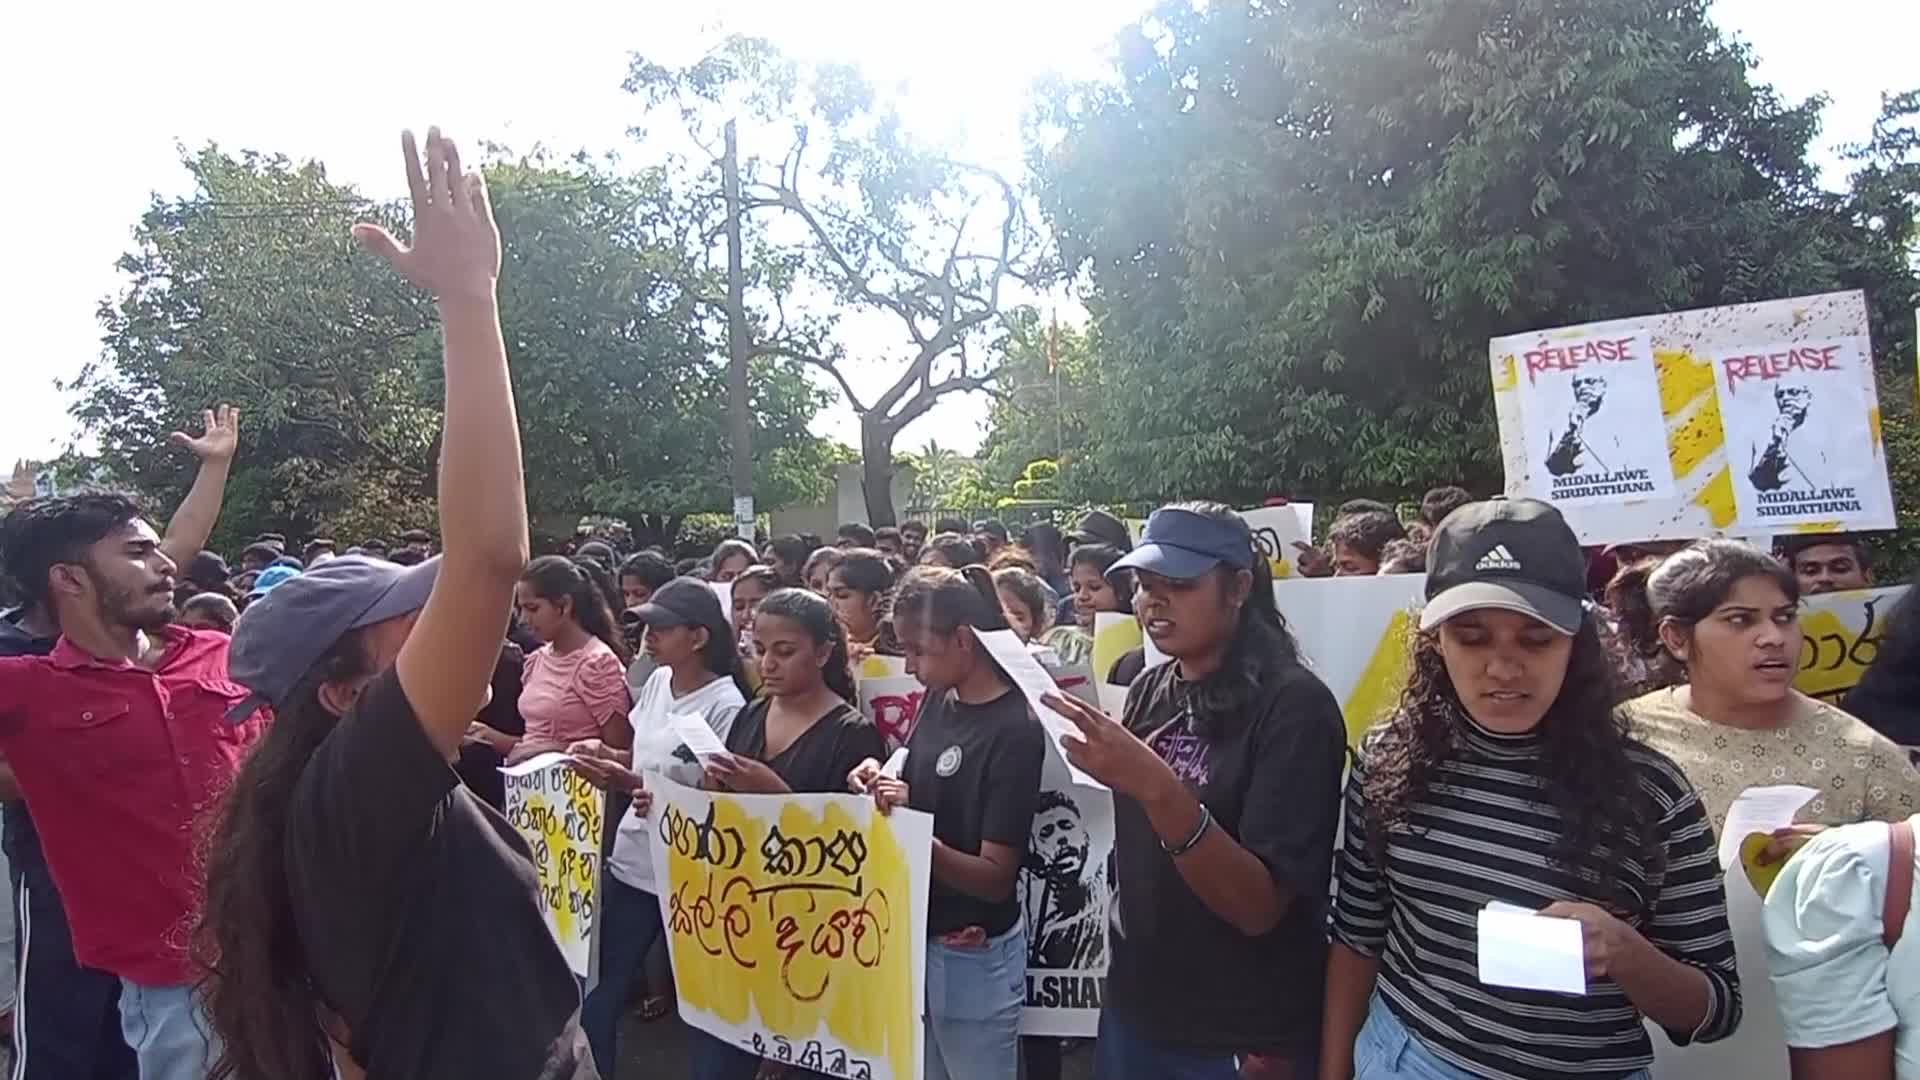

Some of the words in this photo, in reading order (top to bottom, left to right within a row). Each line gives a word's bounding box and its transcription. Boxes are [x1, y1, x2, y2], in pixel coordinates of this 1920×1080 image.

[1523, 337, 1637, 388] RELEASE
[1722, 345, 1844, 396] RELEASE
[1552, 469, 1649, 488] MIDALLAWE
[1551, 481, 1655, 499] SIRIRATHANA
[1757, 487, 1855, 504] MIDALLAWE
[1756, 500, 1862, 516] SIRIRATHANA
[1024, 975, 1102, 1009] LSHA
